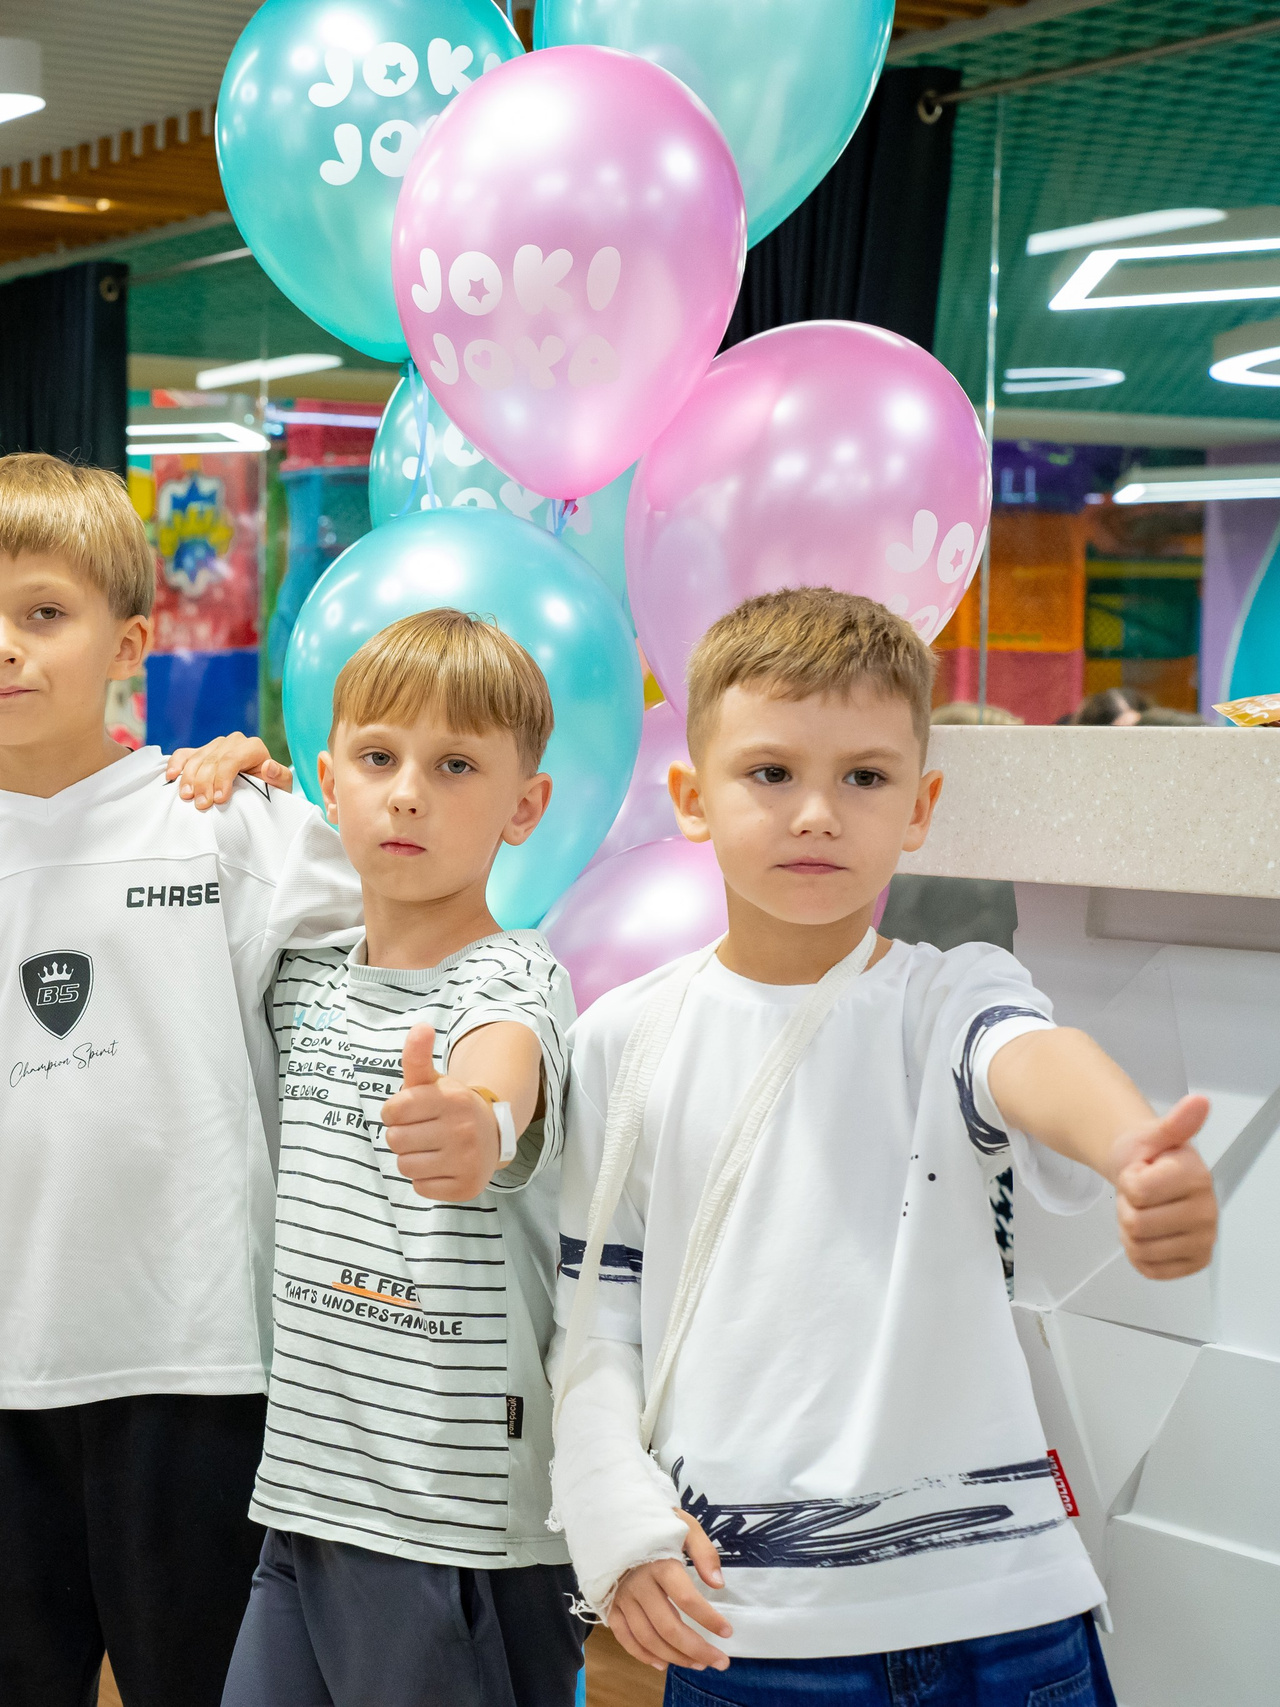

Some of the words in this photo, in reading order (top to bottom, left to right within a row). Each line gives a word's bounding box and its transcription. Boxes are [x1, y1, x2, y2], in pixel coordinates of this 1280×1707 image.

[411, 243, 622, 316] JOKI
[885, 508, 988, 590] JO
[126, 882, 220, 908] CHASE
[10, 1057, 70, 1088] Champion
[72, 1039, 119, 1070] Spirit
[285, 1281, 318, 1304] THAT'S
[340, 1268, 369, 1290] BE
[376, 1278, 421, 1304] FRE
[1047, 1455, 1074, 1513] GULLIVER
